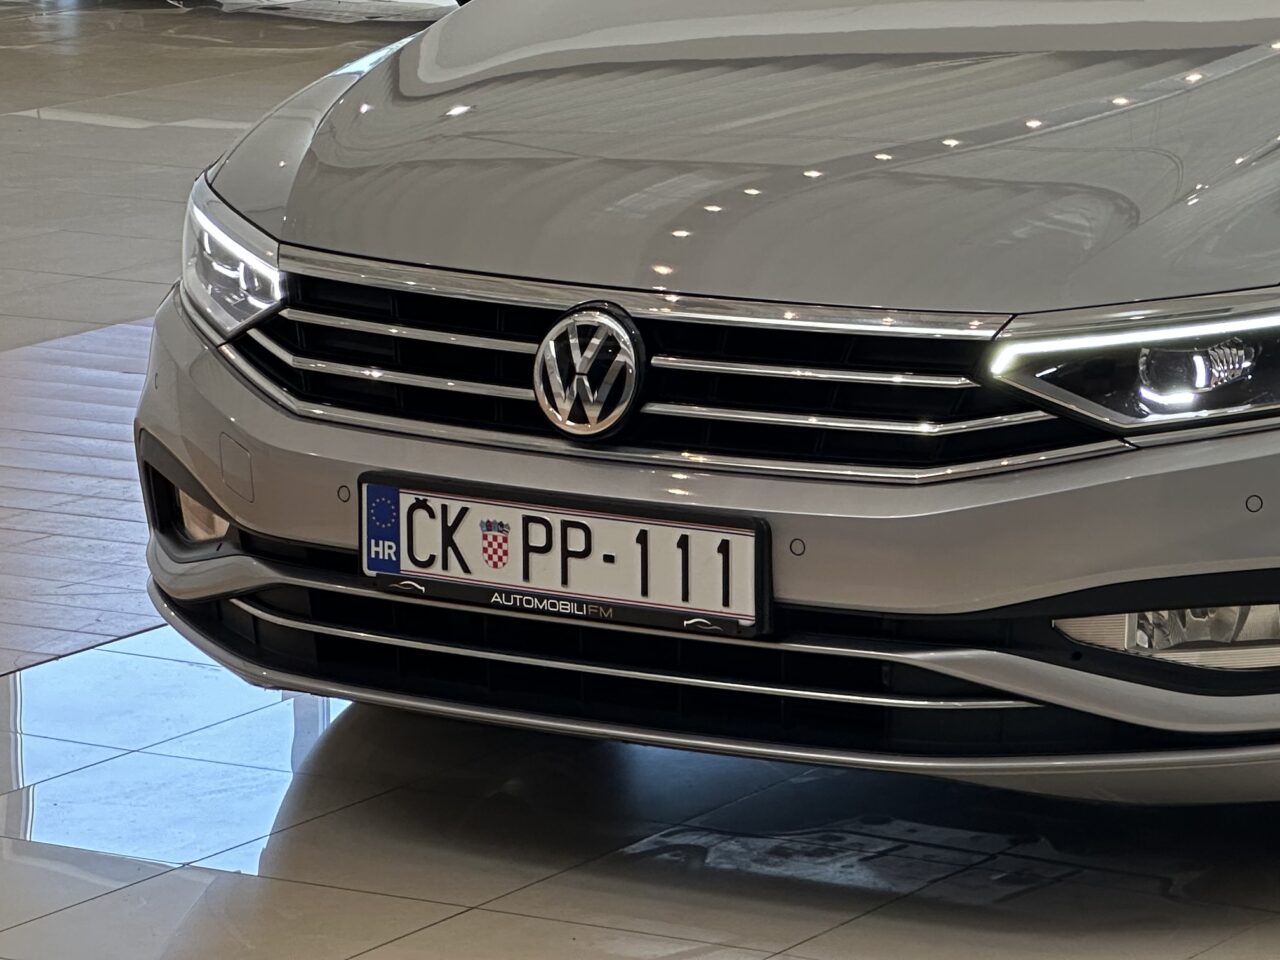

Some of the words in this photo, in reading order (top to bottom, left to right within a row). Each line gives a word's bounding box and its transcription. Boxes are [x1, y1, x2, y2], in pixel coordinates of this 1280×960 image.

[370, 539, 397, 561] HR
[406, 497, 472, 575] ČK
[521, 514, 731, 608] PP-111
